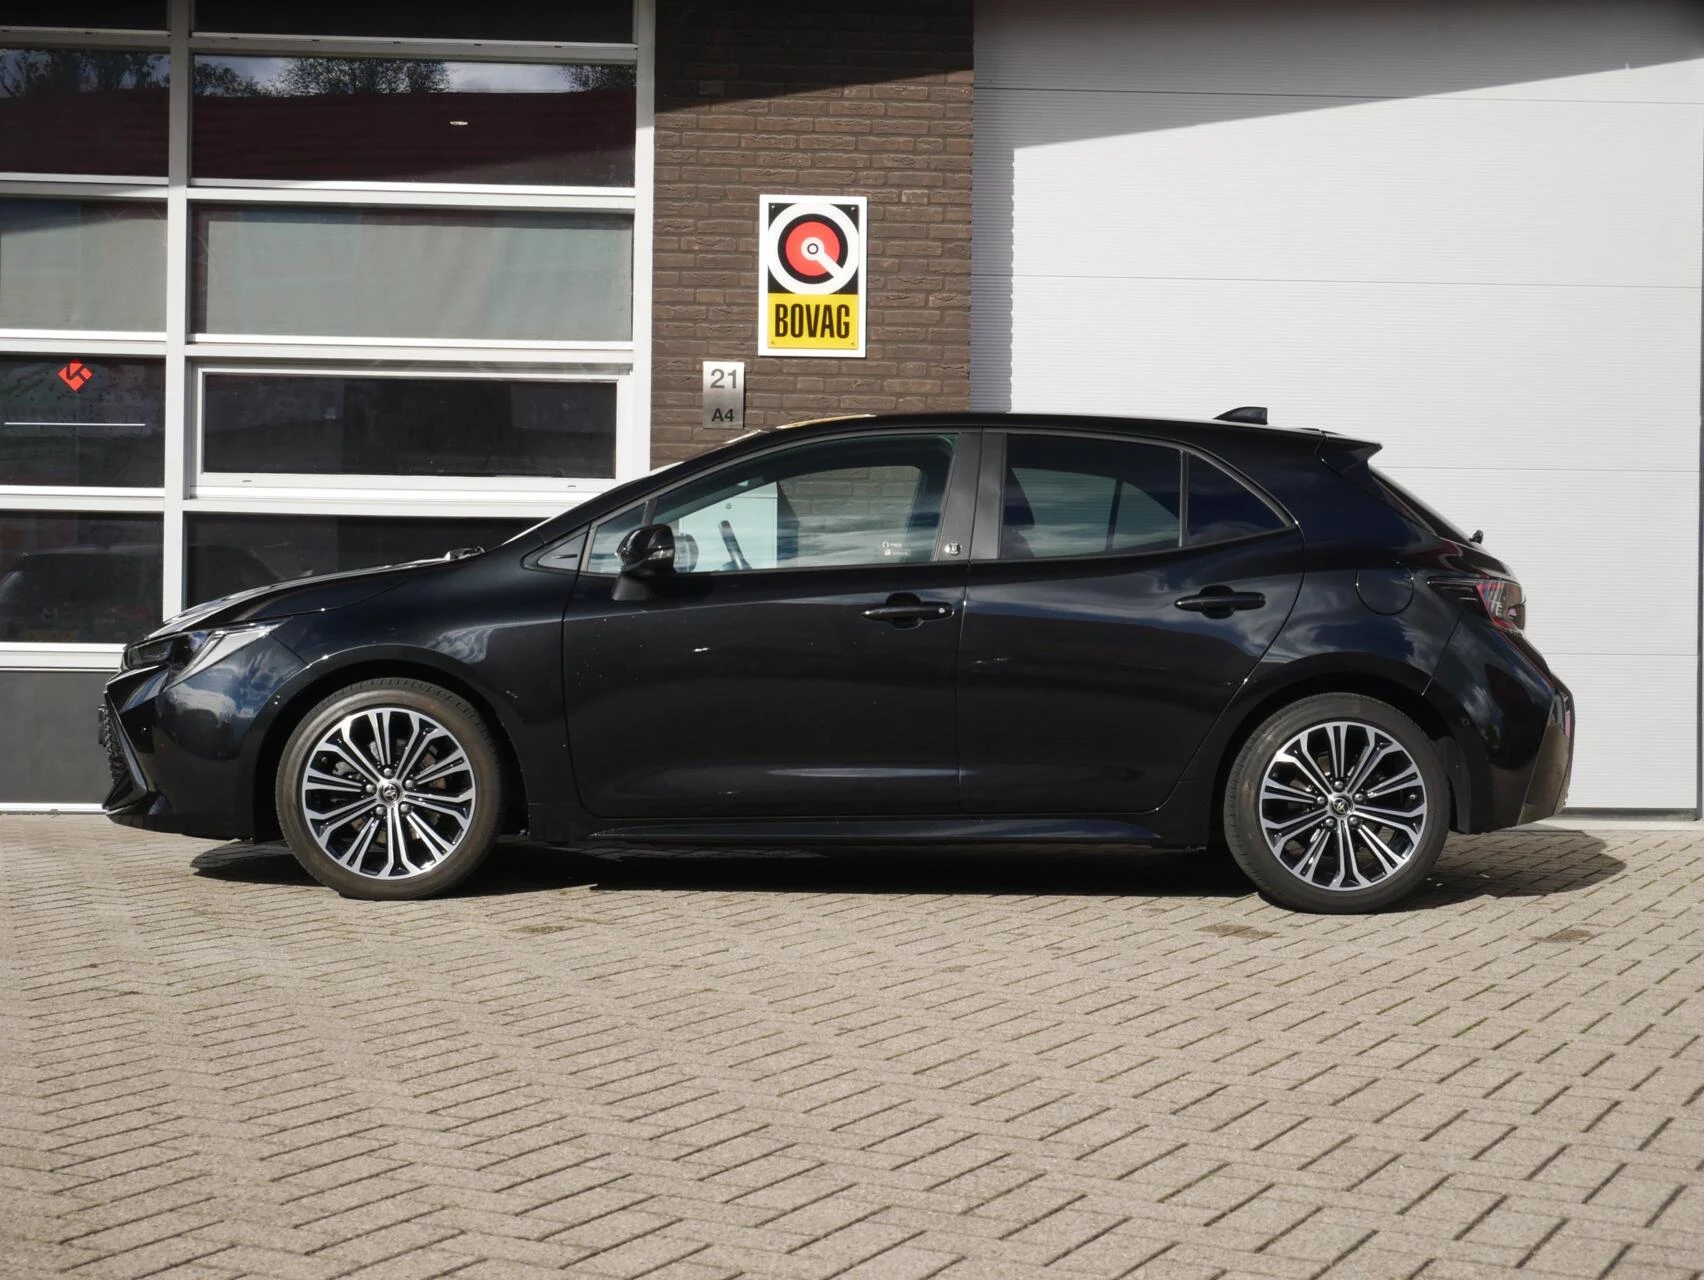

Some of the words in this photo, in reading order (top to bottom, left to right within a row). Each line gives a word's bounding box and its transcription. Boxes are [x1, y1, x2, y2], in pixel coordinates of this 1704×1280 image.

[775, 303, 850, 339] BOVAG
[710, 368, 737, 389] 21
[711, 408, 735, 422] A4
